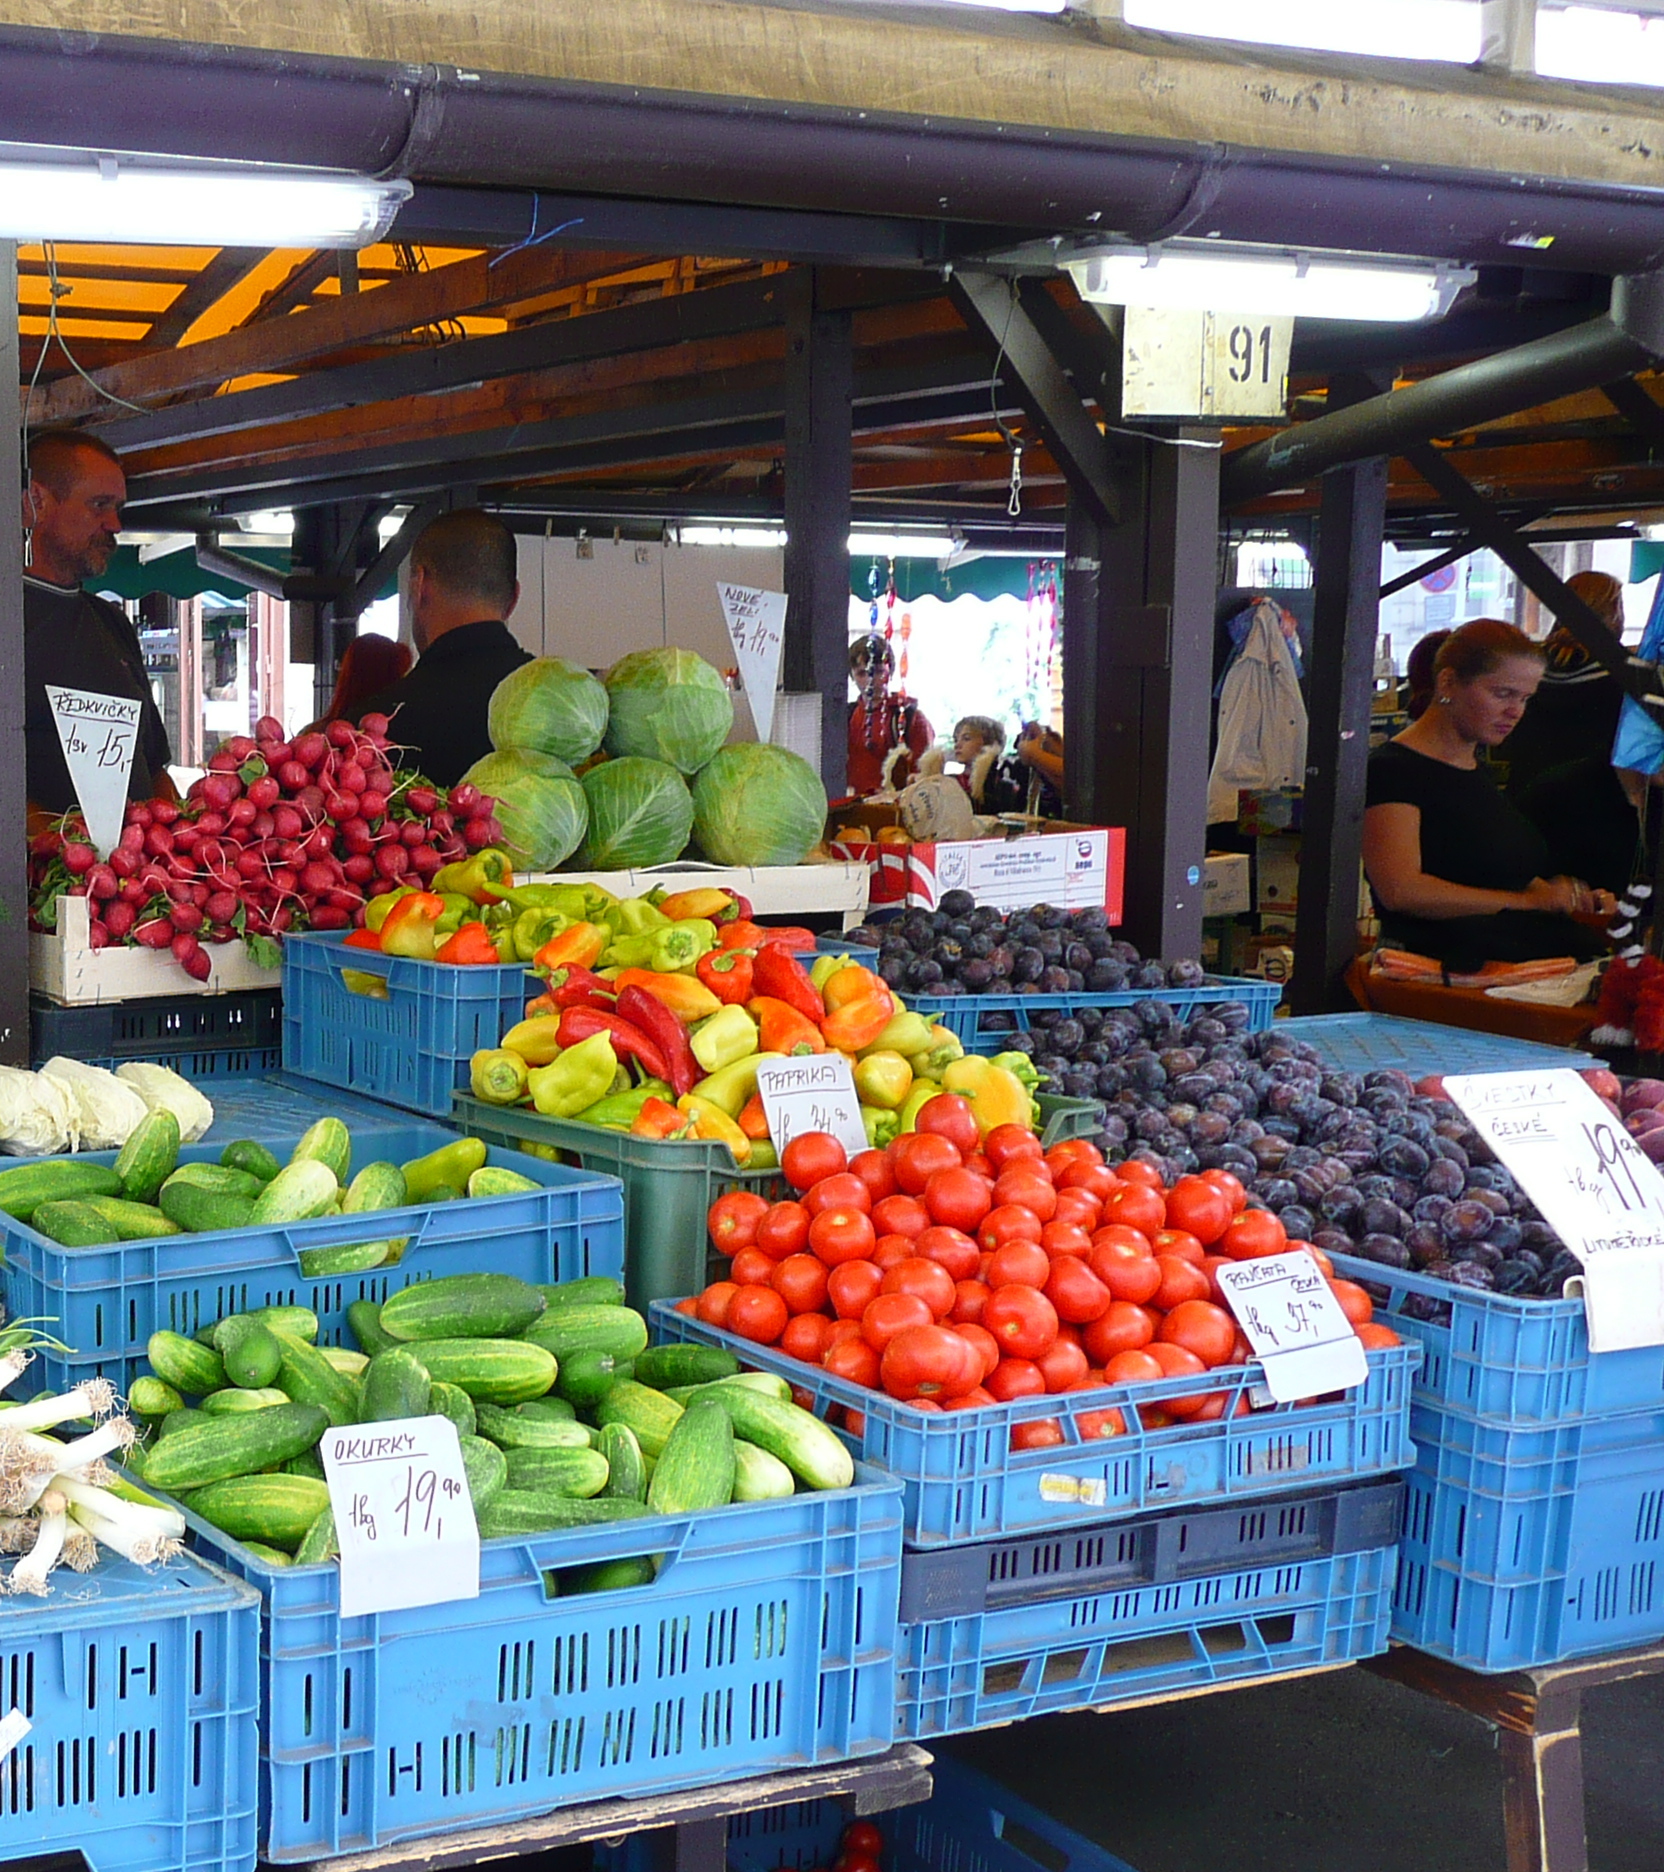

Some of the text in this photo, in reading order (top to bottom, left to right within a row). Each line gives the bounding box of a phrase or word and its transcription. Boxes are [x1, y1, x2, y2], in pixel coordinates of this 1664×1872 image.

[1229, 326, 1270, 383] 91
[53, 691, 137, 721] ŘEDKVIČKY
[761, 1066, 836, 1092] PAPRIKA
[335, 1433, 416, 1460] OKURKY
